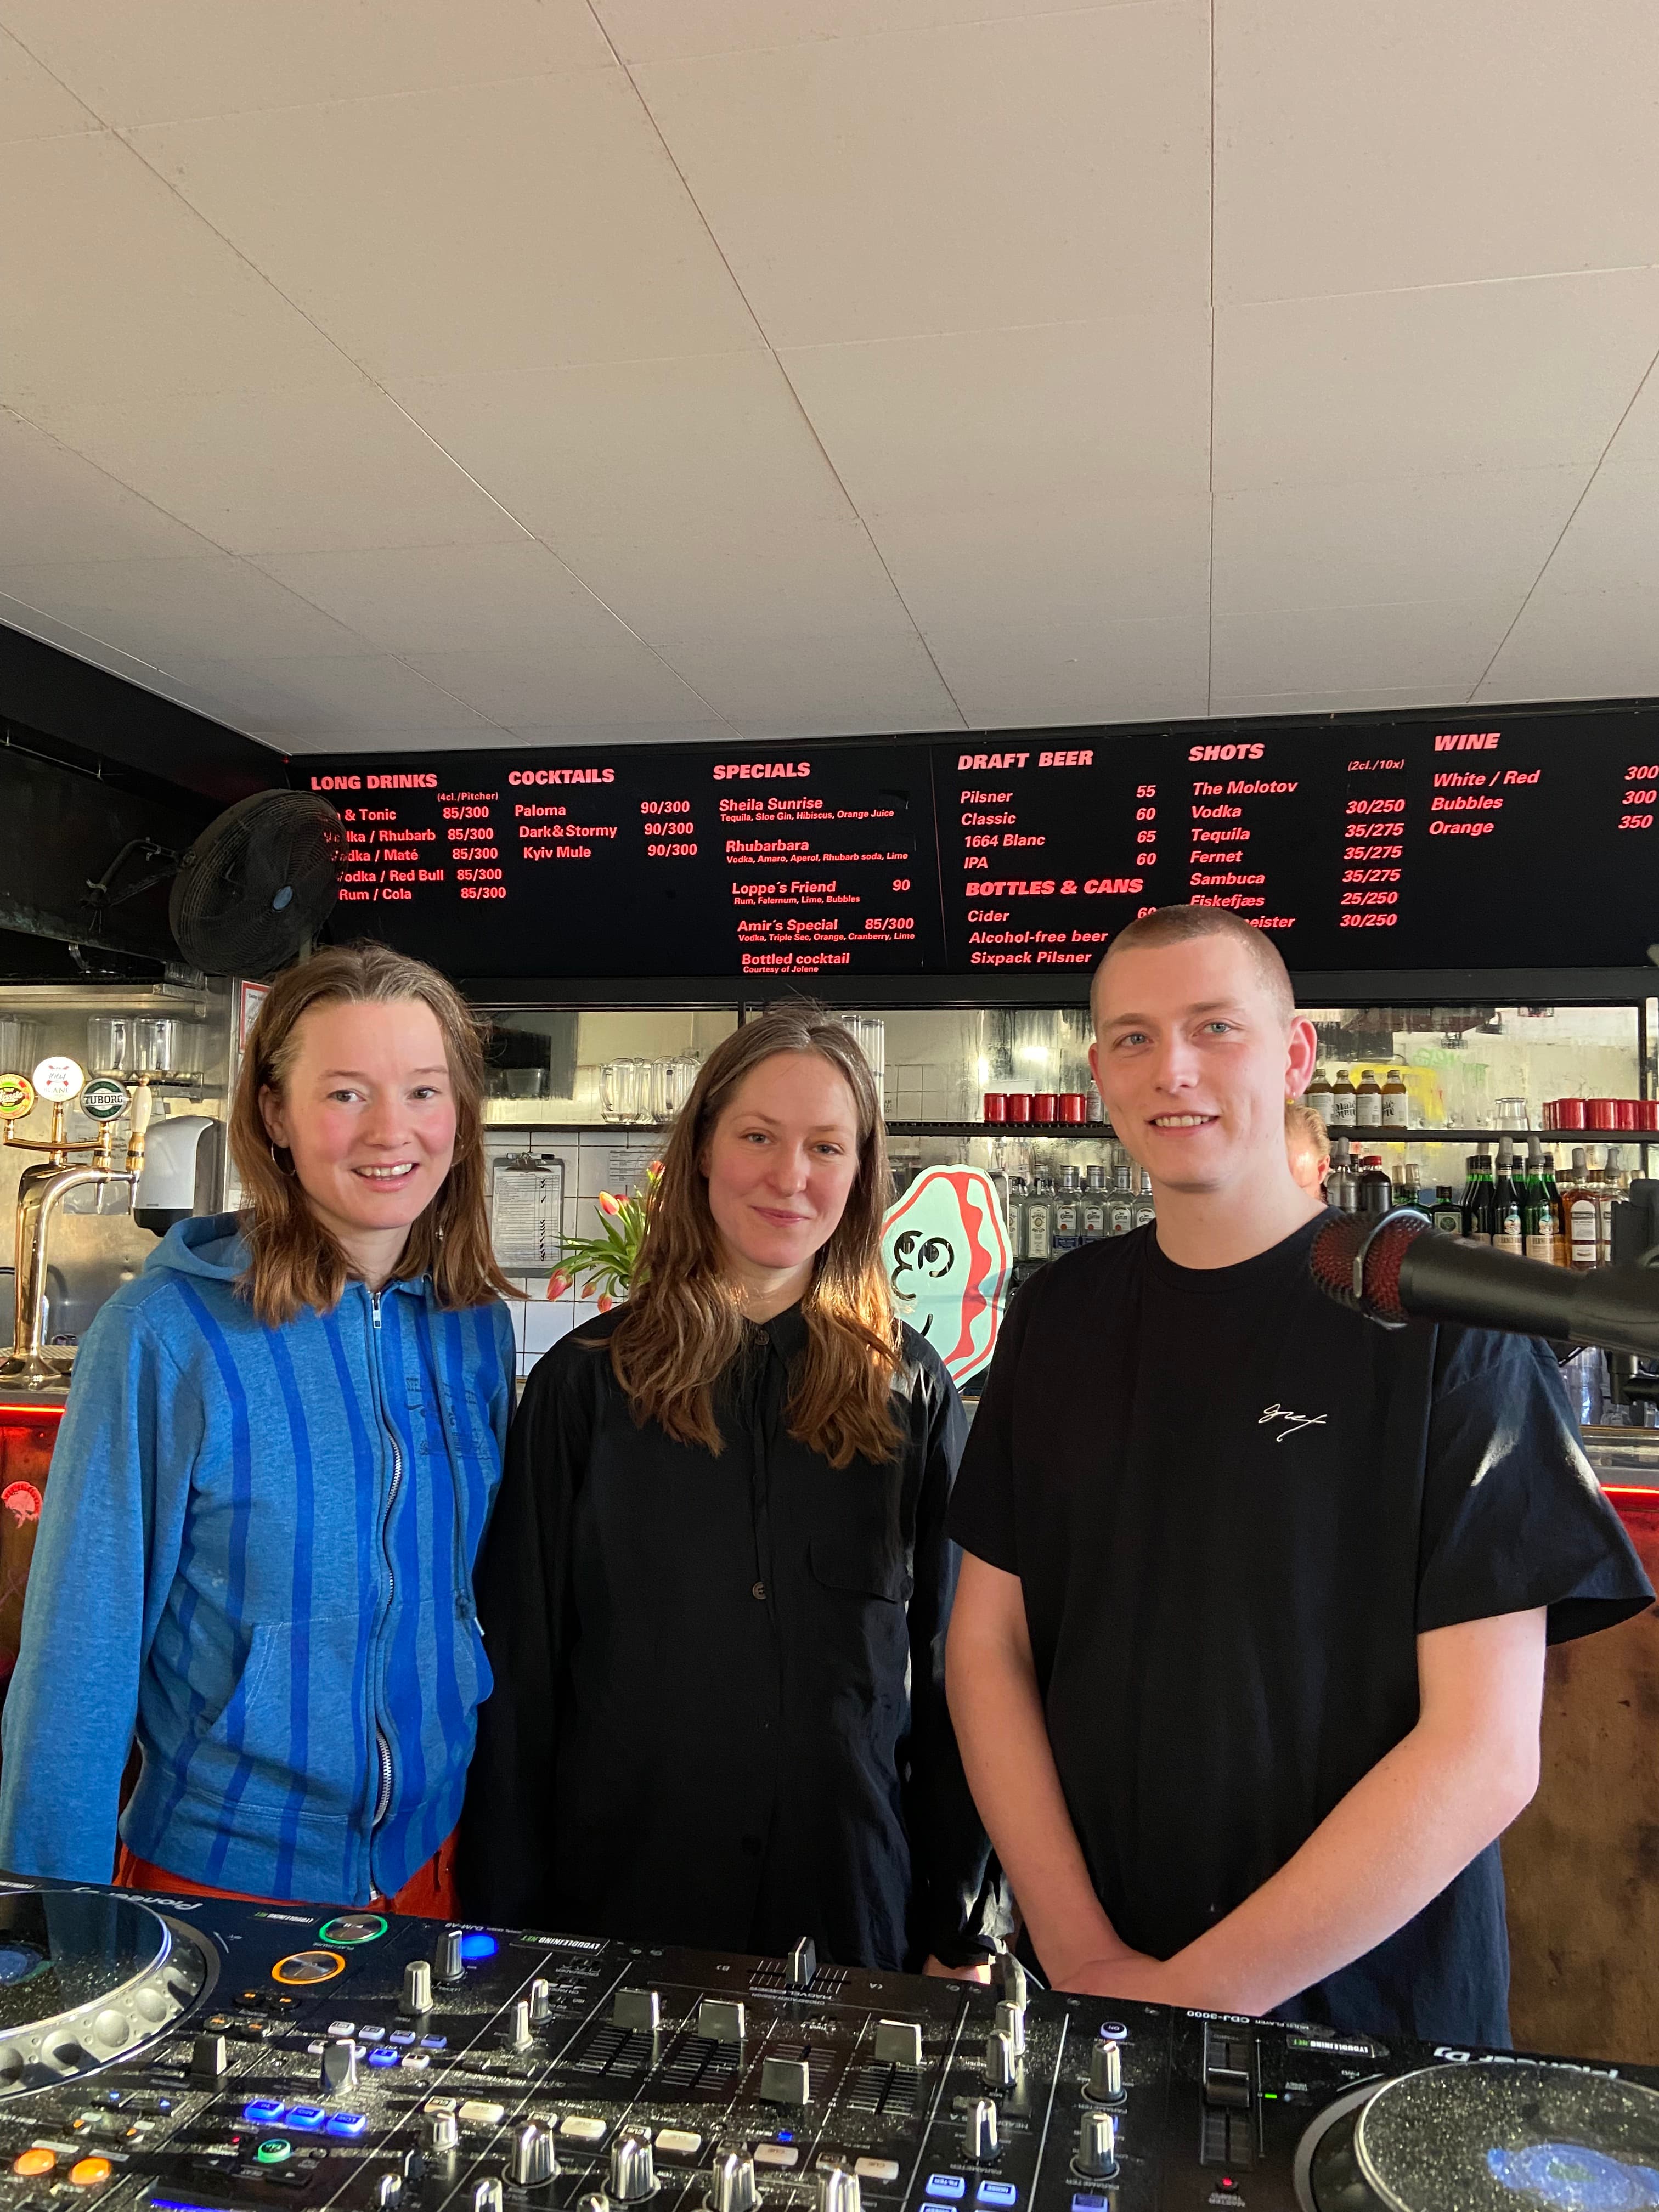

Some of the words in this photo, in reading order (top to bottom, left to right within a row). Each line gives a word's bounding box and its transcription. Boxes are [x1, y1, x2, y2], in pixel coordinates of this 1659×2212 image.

[1435, 733, 1500, 751] WINE
[1188, 743, 1264, 761] SHOTS
[958, 753, 1029, 769] DRAFT
[1039, 751, 1093, 766] BEER
[509, 769, 614, 785] COCKTAILS
[713, 762, 810, 780] SPECIALS
[1624, 765, 1659, 780] 300
[311, 776, 361, 790] LONG
[367, 774, 437, 789] DRINKS
[1434, 772, 1486, 787] White
[1489, 771, 1500, 786] /
[1503, 770, 1541, 784] Red
[1136, 785, 1155, 798] 55
[1193, 782, 1223, 795] The
[1227, 780, 1298, 794] Molotov
[961, 791, 1012, 803] Pilsner
[1431, 795, 1503, 810] Bubbles
[1622, 790, 1657, 804] 300
[515, 805, 566, 816] Paloma
[641, 801, 690, 814] 90/300
[719, 799, 764, 811] Sheila
[768, 797, 823, 810] Sunrise
[1346, 799, 1405, 814] 30/250
[345, 809, 356, 821] &
[359, 809, 396, 820] Tonic
[443, 806, 489, 820] 85/300
[720, 813, 754, 823] Tequila,
[755, 812, 775, 821] Sloe
[776, 812, 794, 821] Gin,
[837, 810, 869, 819] Orange
[1136, 808, 1155, 820] 60
[1192, 805, 1242, 818] Vodka
[962, 812, 1016, 825] Classic
[1618, 815, 1653, 828] 350
[448, 828, 494, 841] 85/300
[645, 822, 693, 836] 90/300
[1192, 827, 1250, 843] Tequila
[1345, 823, 1404, 838] 35/275
[1429, 821, 1494, 836] Orange
[369, 831, 375, 843] /
[379, 830, 436, 842] Rhubarb
[966, 835, 998, 847] 1664
[1003, 834, 1046, 846] Blanc
[1137, 831, 1156, 843] 65
[648, 844, 697, 857] 90/300
[726, 839, 809, 853] Rhubarbara
[375, 850, 380, 862] /
[384, 849, 418, 860] Maté
[453, 848, 498, 860] 85/300
[524, 847, 553, 861] Kyiv
[557, 846, 591, 857] Mule
[726, 856, 756, 864] Vodka,
[757, 855, 788, 863] Amaro,
[790, 854, 821, 863] Aperol,
[1137, 853, 1156, 865] 60
[1190, 850, 1243, 863] Fernet
[1344, 846, 1402, 860] 35/275
[964, 857, 988, 869] IPA
[380, 871, 385, 882] /
[390, 870, 415, 881] Red
[419, 870, 444, 881] Bull
[457, 869, 502, 881] 85/300
[1190, 872, 1265, 885] Sambuca
[1342, 869, 1401, 883] 35/275
[791, 881, 837, 893] Friend
[893, 879, 910, 891] 90
[966, 880, 1055, 896] BOTTLES
[1060, 880, 1077, 894] &
[1084, 879, 1143, 894] CANS
[339, 889, 369, 900] Rum
[373, 889, 379, 901] /
[382, 888, 411, 899] Cola
[461, 887, 506, 899] 85/300
[1341, 892, 1398, 905] 25/250
[734, 895, 755, 905] Rum,
[758, 895, 799, 904] Falernum,
[1190, 894, 1265, 909] Fiskefjæs
[968, 910, 1009, 922] Cider
[1340, 914, 1397, 927] 30/250
[787, 919, 838, 933] Special
[865, 918, 914, 930] 85/300
[769, 934, 792, 942] Triple
[814, 933, 846, 941] Orange,
[969, 931, 1066, 943] Alcohol-free
[1071, 930, 1108, 941] beer
[742, 953, 792, 965] Bottled
[796, 953, 850, 964] cocktail
[971, 952, 1031, 966] Sixpack
[1037, 951, 1092, 962] Pilsner
[85, 1095, 123, 1104] TUBORG
[1187, 2010, 1250, 2024] CDJ-3000
